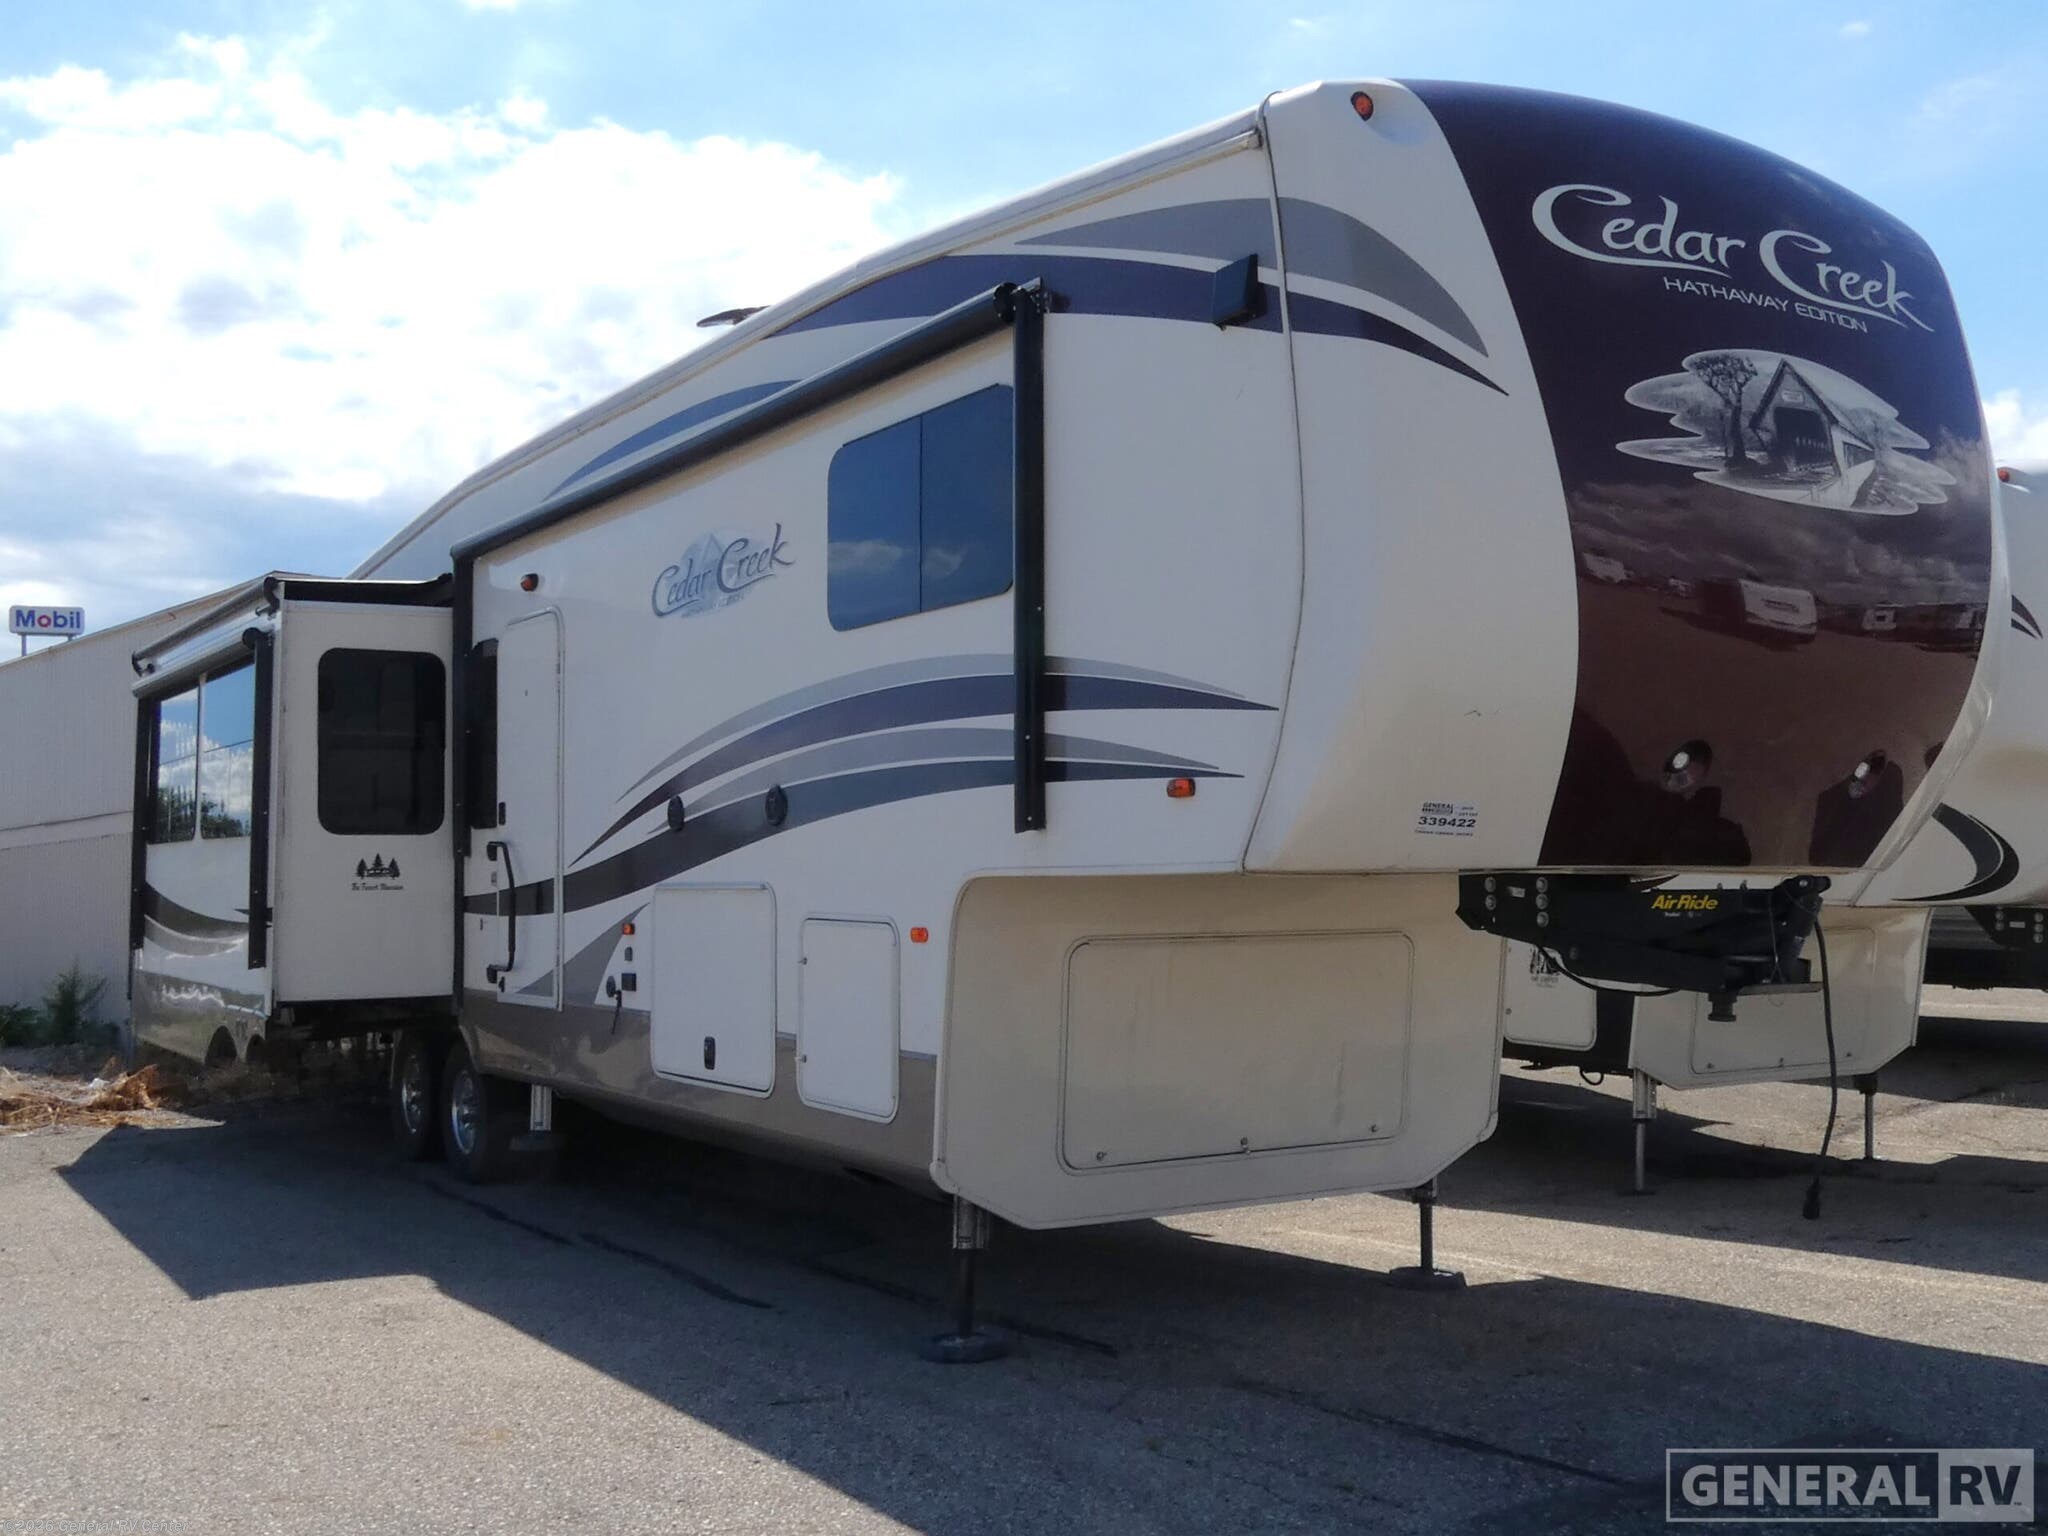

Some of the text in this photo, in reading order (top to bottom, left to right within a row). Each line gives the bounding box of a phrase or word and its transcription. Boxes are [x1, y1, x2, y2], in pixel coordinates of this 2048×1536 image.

[1532, 184, 1935, 332] Cedar Creek
[1663, 276, 1868, 333] HATHAWAY EDITION
[652, 523, 795, 617] Cedar Creek
[15, 609, 80, 629] Mobil
[1418, 816, 1476, 828] 339422
